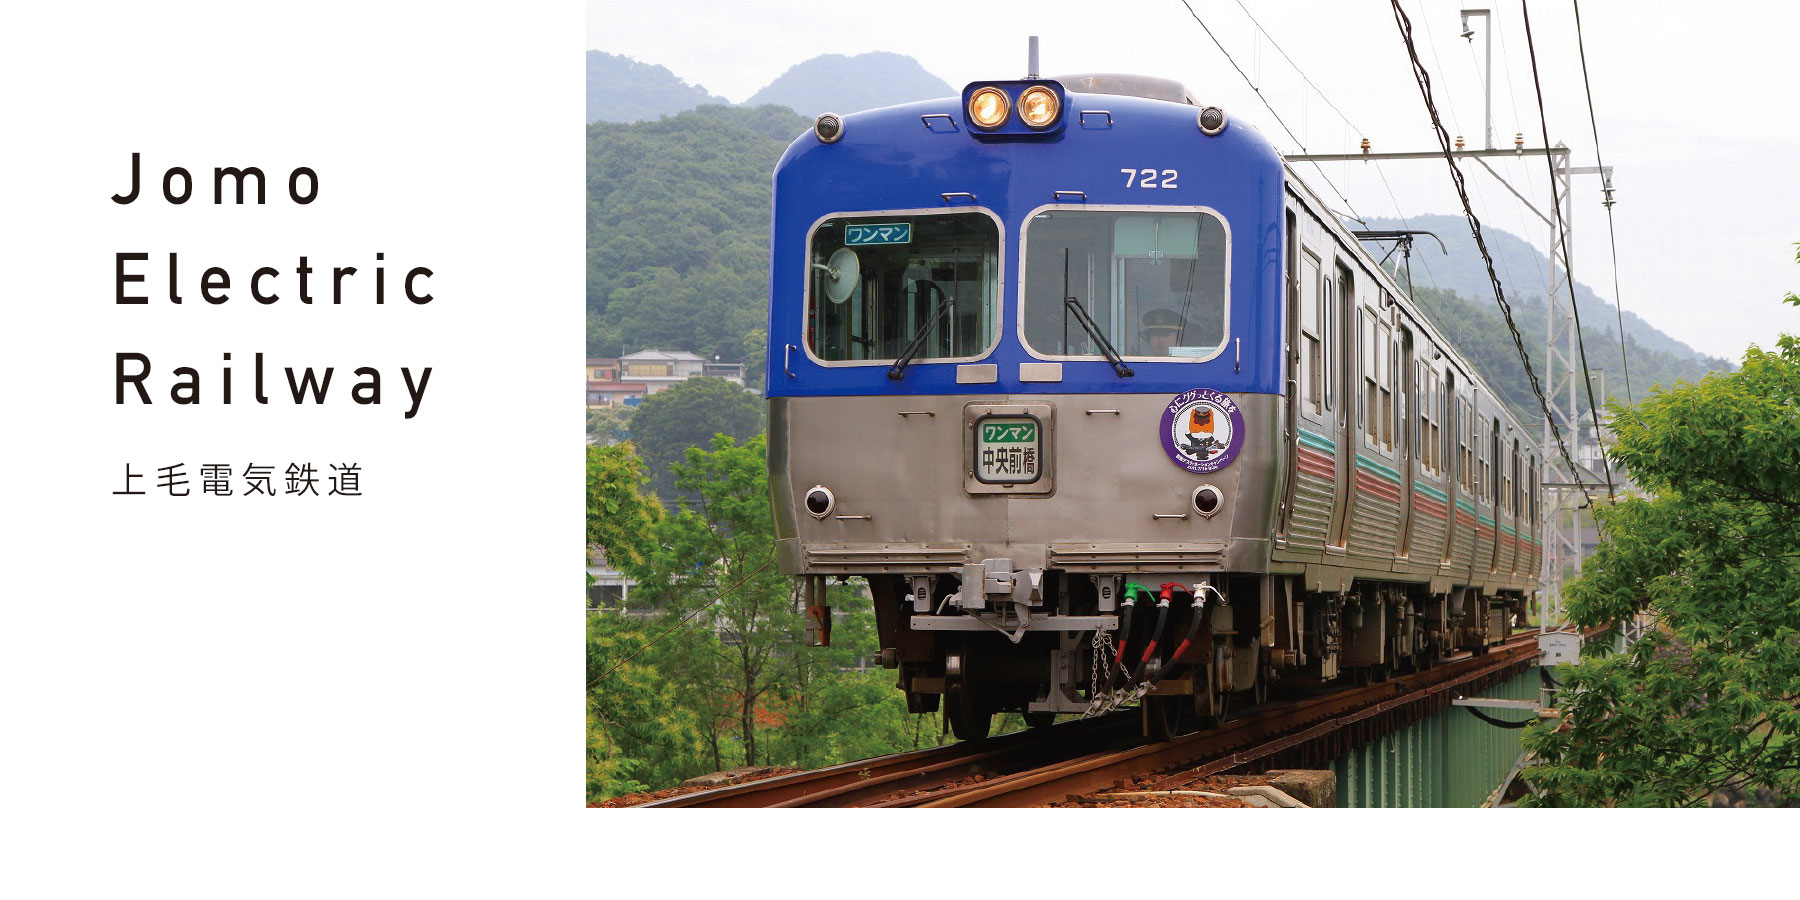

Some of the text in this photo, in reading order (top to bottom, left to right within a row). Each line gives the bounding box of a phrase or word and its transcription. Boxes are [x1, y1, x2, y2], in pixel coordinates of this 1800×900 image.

[1120, 168, 1178, 189] 722
[848, 226, 908, 243] ワンマン
[985, 426, 1034, 440] ワンマン
[982, 446, 1035, 474] 中央前橋
